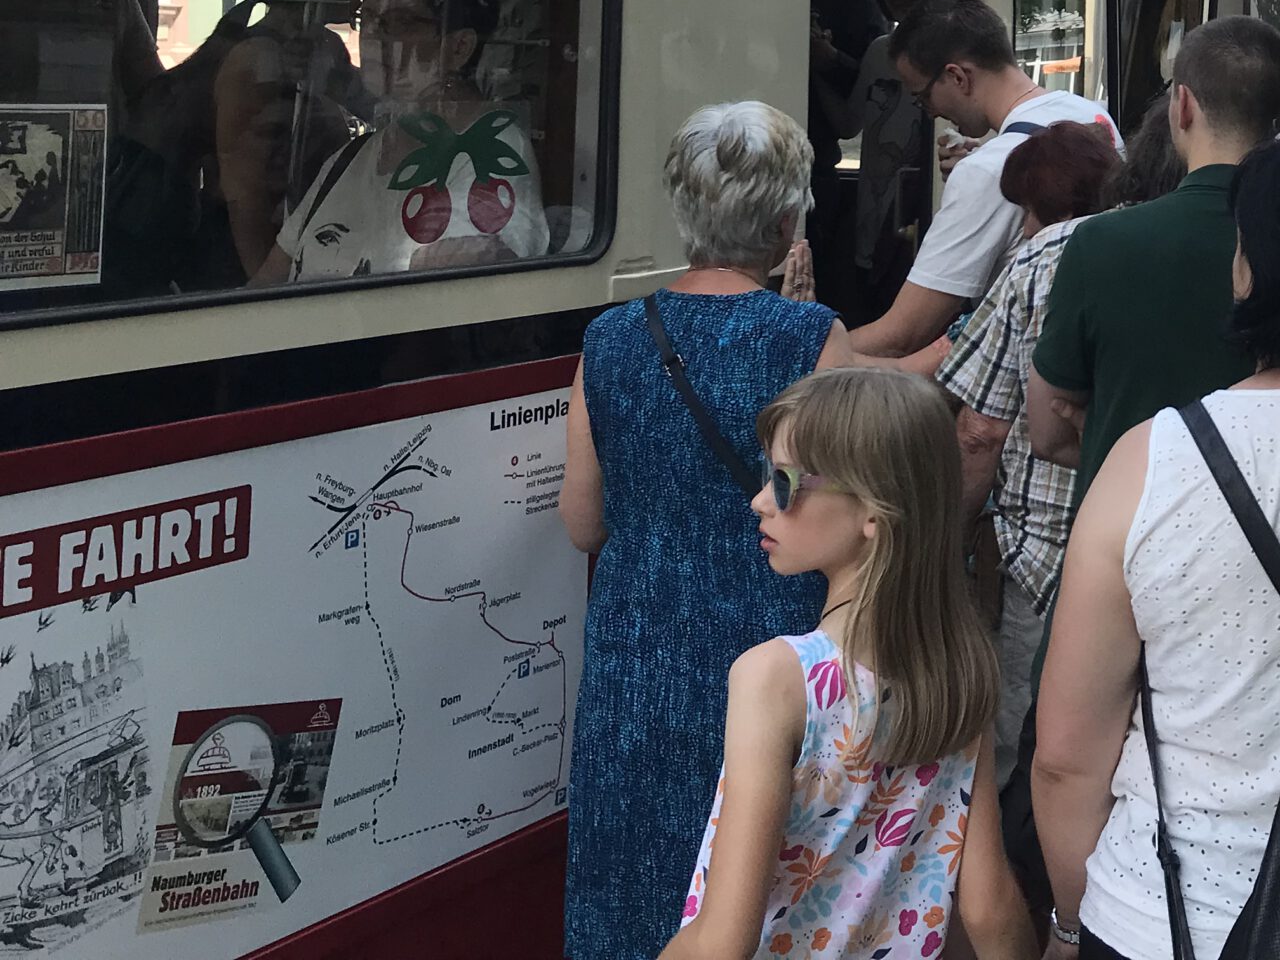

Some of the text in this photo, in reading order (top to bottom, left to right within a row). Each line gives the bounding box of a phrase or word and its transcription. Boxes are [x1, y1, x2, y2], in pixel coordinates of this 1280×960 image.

[490, 398, 570, 432] Linienpla
[390, 423, 433, 466] Halle/Leipzig
[527, 452, 542, 463] Linie
[440, 464, 453, 478] Ost
[317, 485, 346, 505] Wangen
[323, 474, 356, 498] Freyburg-
[372, 482, 424, 502] Hauptbahnhof
[526, 500, 560, 516] Streckenab
[322, 511, 363, 551] Erfurt/Jena
[415, 515, 461, 534] Wiesenstraße
[0, 496, 239, 608] E FAHRT!
[444, 578, 481, 596] Nordstraße
[488, 591, 522, 608] Jägerplatz
[317, 604, 364, 623] Markgrafen-
[344, 614, 361, 626] weg
[542, 614, 567, 630] Depot
[503, 647, 536, 665] Poststraße
[440, 693, 462, 708] Dom
[451, 706, 488, 726] Lindenring
[521, 706, 540, 719] Markt
[354, 718, 395, 740] Moritzplatz
[467, 733, 515, 760] Innenstadt
[195, 783, 222, 800] 1892
[333, 778, 391, 808] Michaelisstraße
[522, 778, 556, 798] Vogelwiese
[326, 821, 371, 846] Kösener Str.
[466, 823, 490, 839] Salztor
[151, 868, 228, 892] Naumburger
[158, 879, 260, 913] Straßenbahn
[2, 908, 38, 925] Zicke
